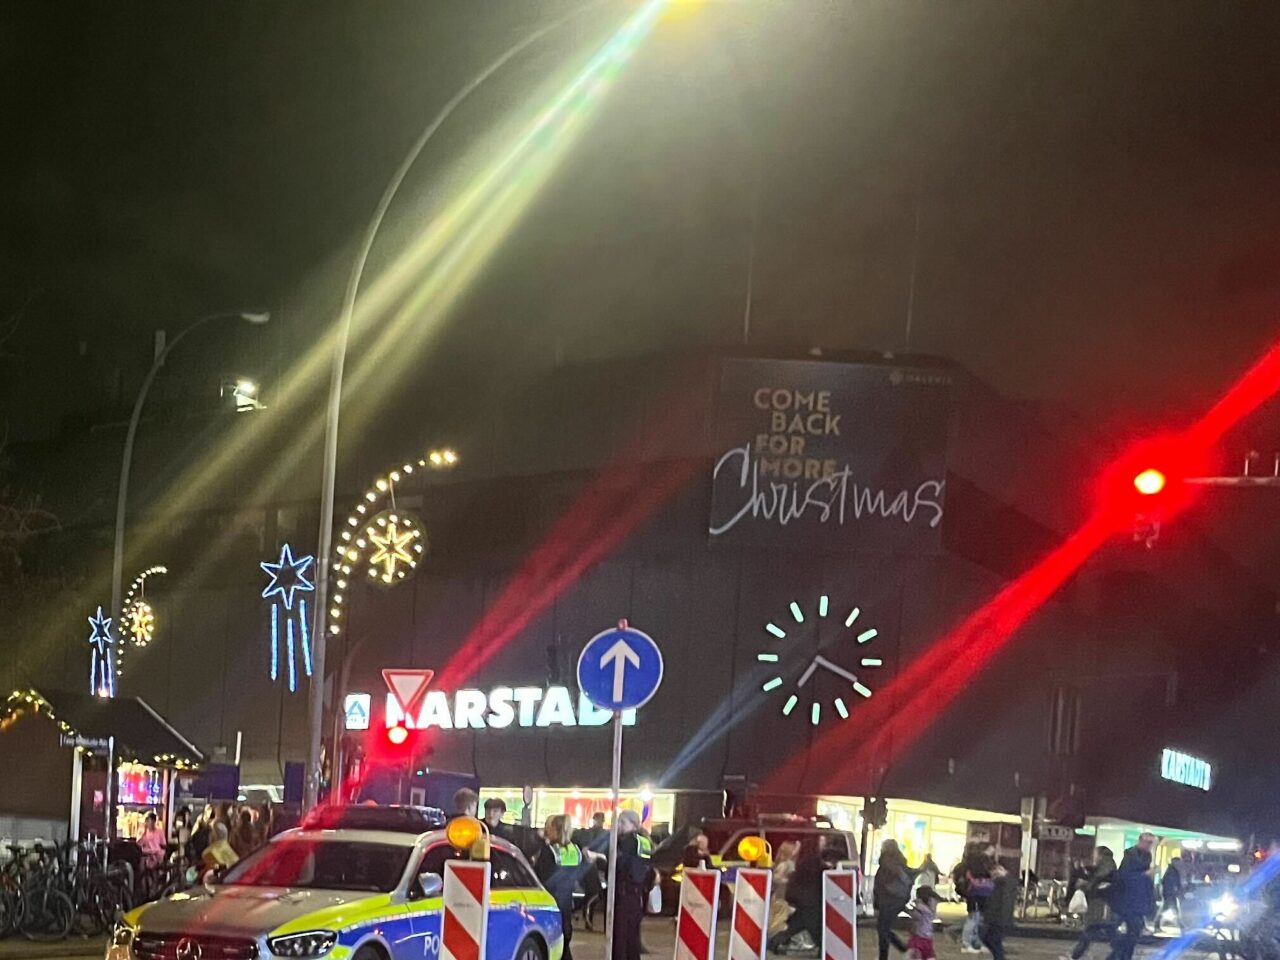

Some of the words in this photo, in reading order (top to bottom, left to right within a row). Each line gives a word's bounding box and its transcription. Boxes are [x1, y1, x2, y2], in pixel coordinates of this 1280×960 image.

[753, 387, 833, 412] COME
[771, 412, 841, 436] BACK
[755, 433, 807, 456] FOR
[760, 457, 838, 480] MORE
[709, 442, 946, 536] Christmas
[386, 686, 637, 729] KARSTAD
